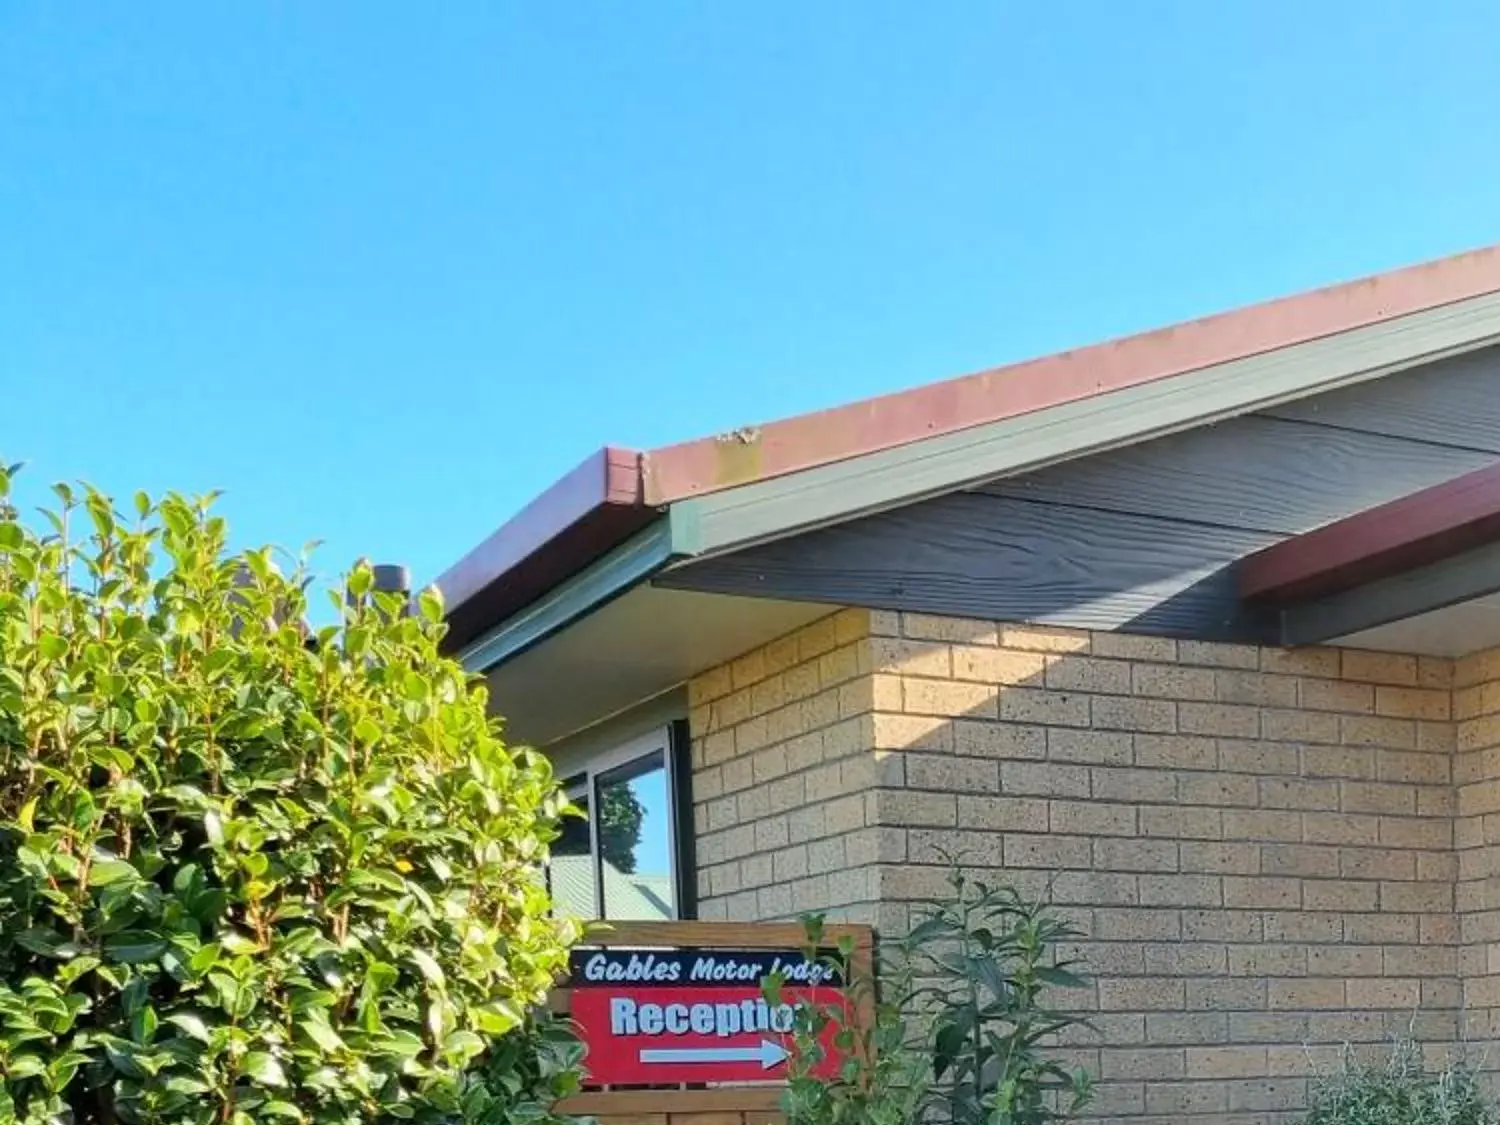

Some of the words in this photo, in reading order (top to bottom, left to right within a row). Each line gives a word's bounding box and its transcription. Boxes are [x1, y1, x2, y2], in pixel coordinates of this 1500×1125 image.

[584, 953, 681, 982] Gables
[690, 956, 764, 981] Motor
[609, 995, 812, 1038] Receptio
